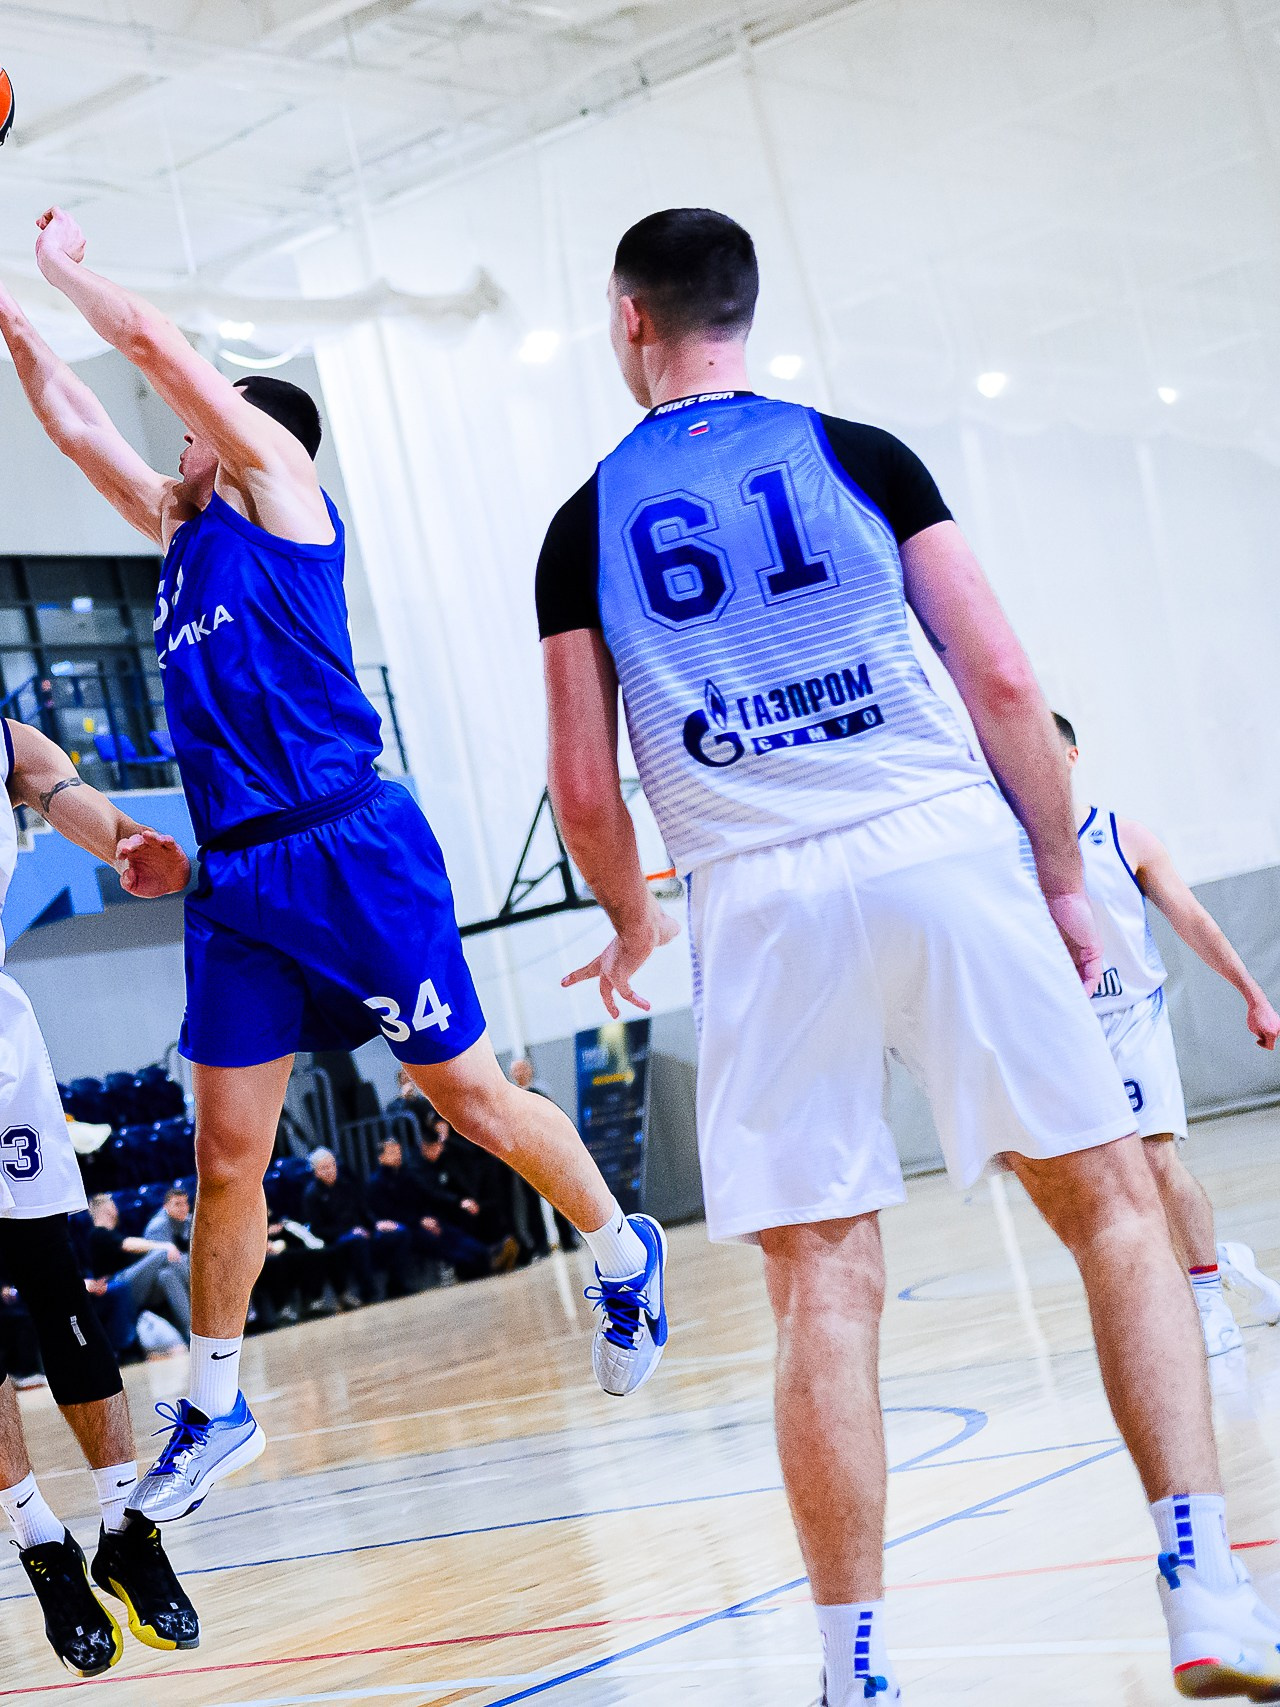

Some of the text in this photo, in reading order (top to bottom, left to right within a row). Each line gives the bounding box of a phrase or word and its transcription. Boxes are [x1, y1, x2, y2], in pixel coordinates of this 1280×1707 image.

[620, 460, 840, 633] 61
[736, 663, 874, 730] ГАЗПРОМ
[362, 978, 453, 1043] 34
[0, 1123, 44, 1183] 3
